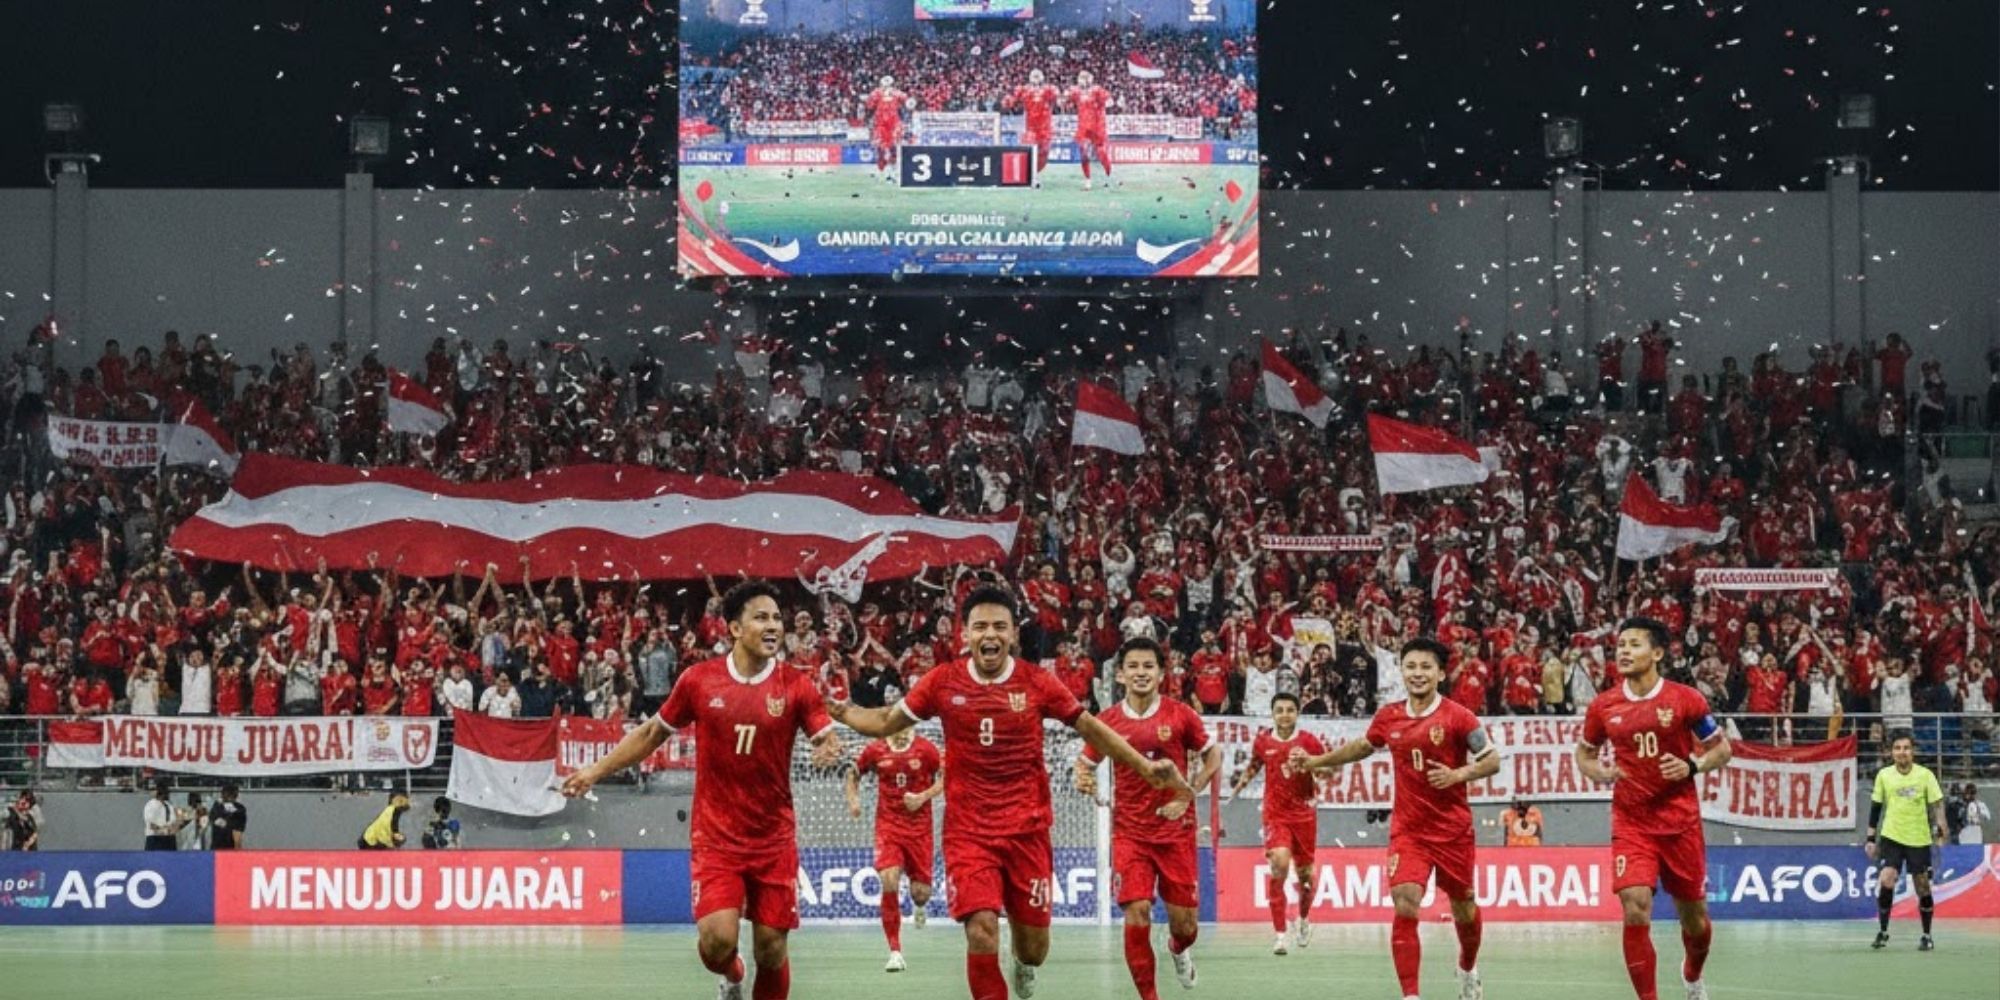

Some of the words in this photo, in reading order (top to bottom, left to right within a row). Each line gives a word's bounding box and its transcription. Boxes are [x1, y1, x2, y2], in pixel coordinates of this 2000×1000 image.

[912, 153, 932, 181] 3
[104, 719, 224, 763] MENUJU
[238, 719, 354, 764] JUARA!
[51, 870, 167, 909] AFO
[250, 866, 423, 910] MENUJU
[435, 866, 584, 910] JUARA!
[1730, 864, 1843, 903] AFO
